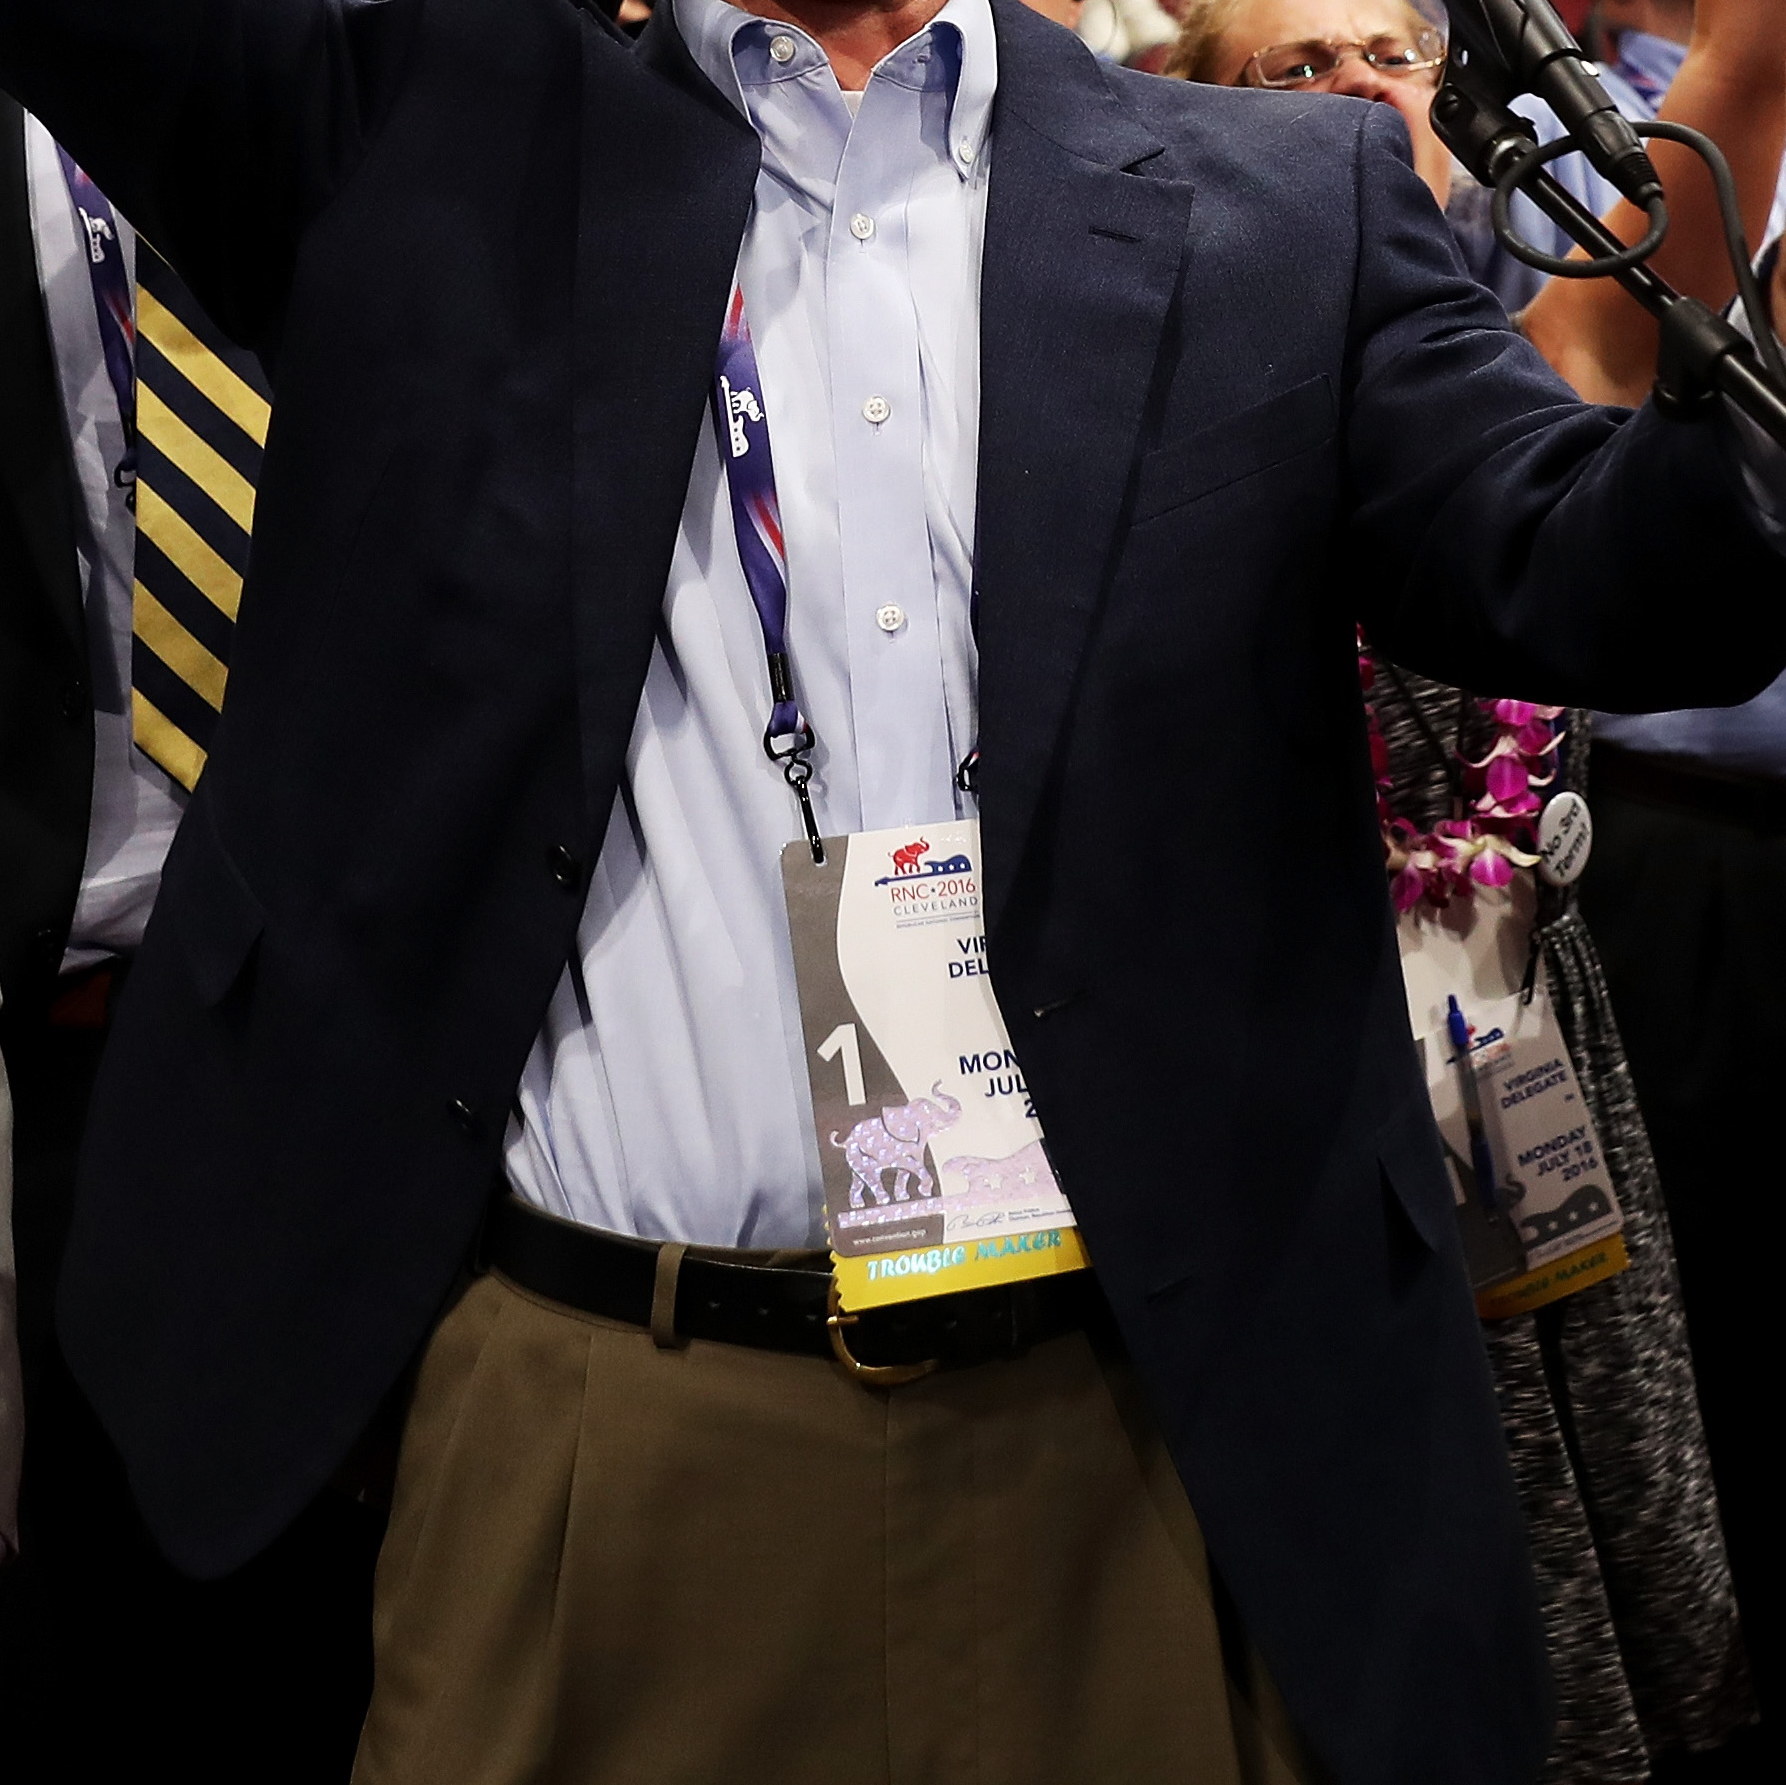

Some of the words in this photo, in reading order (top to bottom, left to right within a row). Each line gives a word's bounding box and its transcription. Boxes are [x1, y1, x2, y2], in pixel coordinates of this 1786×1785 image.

[893, 896, 978, 916] CLEVELAND
[816, 1022, 867, 1107] 1
[1501, 1057, 1565, 1093] VIRGINIA
[1499, 1071, 1569, 1111] DELEGATE
[1517, 1124, 1588, 1169] MONDAY
[1536, 1148, 1576, 1181] JULY
[1575, 1140, 1595, 1162] 18
[1561, 1156, 1600, 1185] 2016
